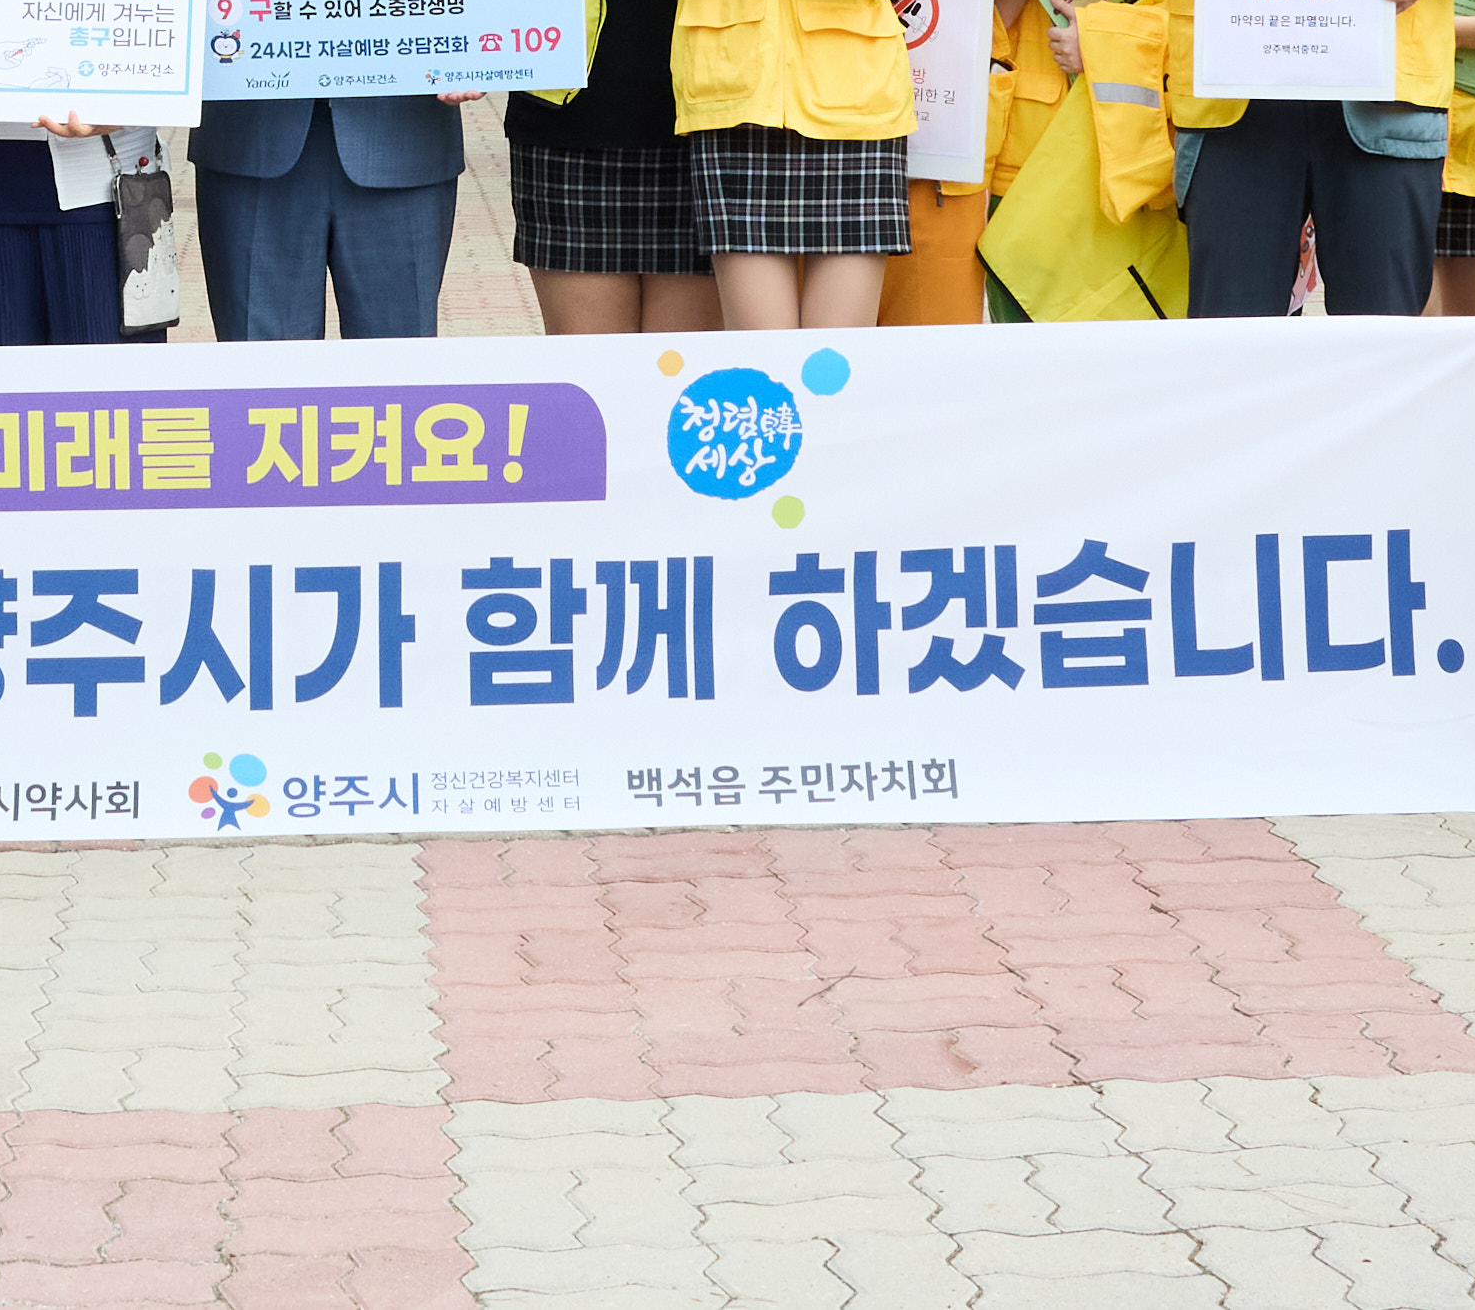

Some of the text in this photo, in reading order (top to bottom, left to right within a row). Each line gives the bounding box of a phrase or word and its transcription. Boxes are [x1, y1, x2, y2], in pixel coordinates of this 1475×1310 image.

[22, 1, 175, 24] 자신에게 겨누는
[299, 0, 317, 20] 수
[324, 0, 361, 19] 있어
[1230, 15, 1356, 28] 마약의 끝은 파멸입니다.
[69, 26, 175, 48] 총구입니다
[250, 26, 561, 60] 24시간 자살예방 상담전화 109
[1263, 44, 1329, 55] 양주백석중학교
[98, 62, 175, 77] 양주시보건소
[245, 68, 533, 90] Yangju 양주시보건소 양주시자살예방센터
[912, 68, 927, 85] 방
[943, 90, 956, 105] 길
[246, 401, 529, 488] 지켜요!
[685, 438, 777, 487] 세상
[461, 555, 716, 706] 함께
[767, 527, 1466, 696] 하겠습니다.
[431, 769, 579, 791] 정신건강복지센터
[626, 758, 960, 806] 백석읍 주민자치회
[284, 772, 420, 818] 양주시
